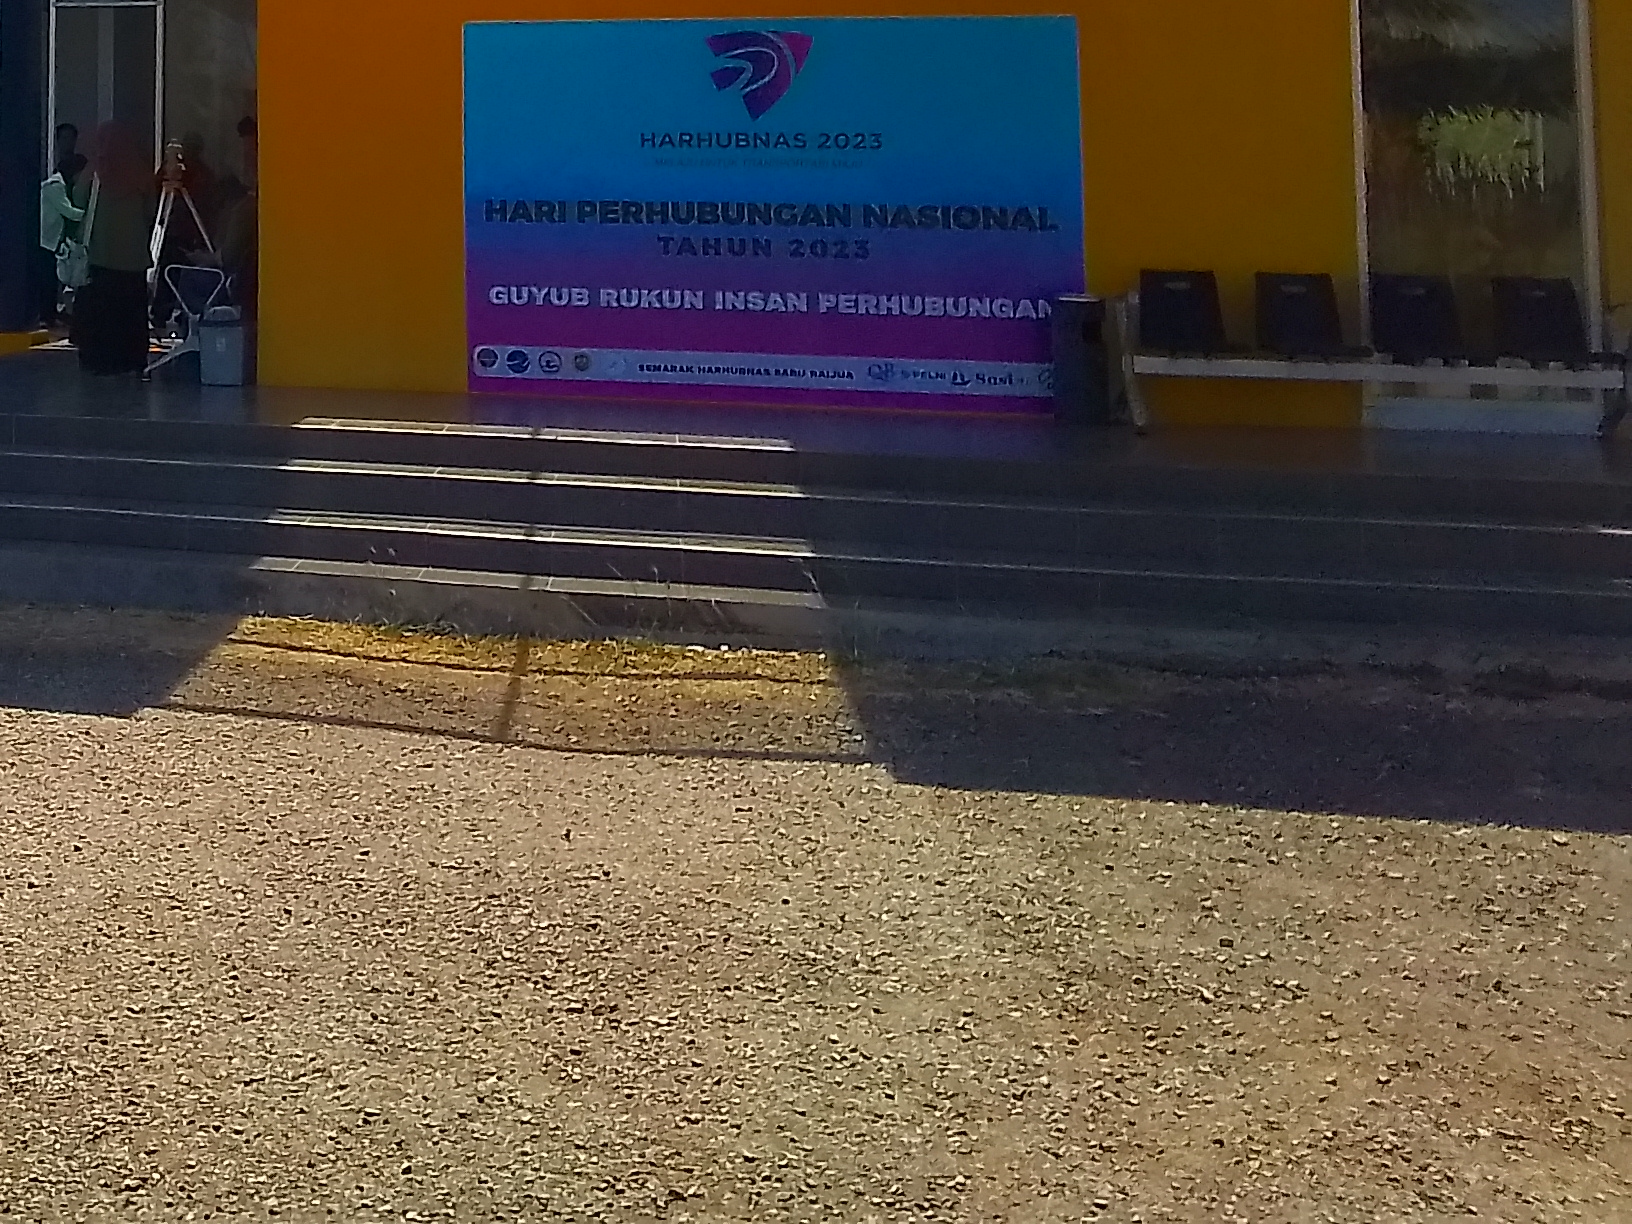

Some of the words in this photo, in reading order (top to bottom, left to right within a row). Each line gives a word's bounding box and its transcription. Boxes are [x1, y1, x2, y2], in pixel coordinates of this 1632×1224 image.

[640, 131, 808, 150] HARHUBNAS
[817, 131, 884, 150] 2023
[483, 197, 567, 225] HARI
[575, 199, 852, 228] PERHUBUNGAN
[862, 203, 1059, 233] NASIONAL
[656, 234, 773, 258] TAHUN
[787, 238, 871, 260] 2023
[488, 284, 591, 307] GUYUB
[598, 288, 705, 310] RUKUN
[714, 290, 808, 313] INSAN
